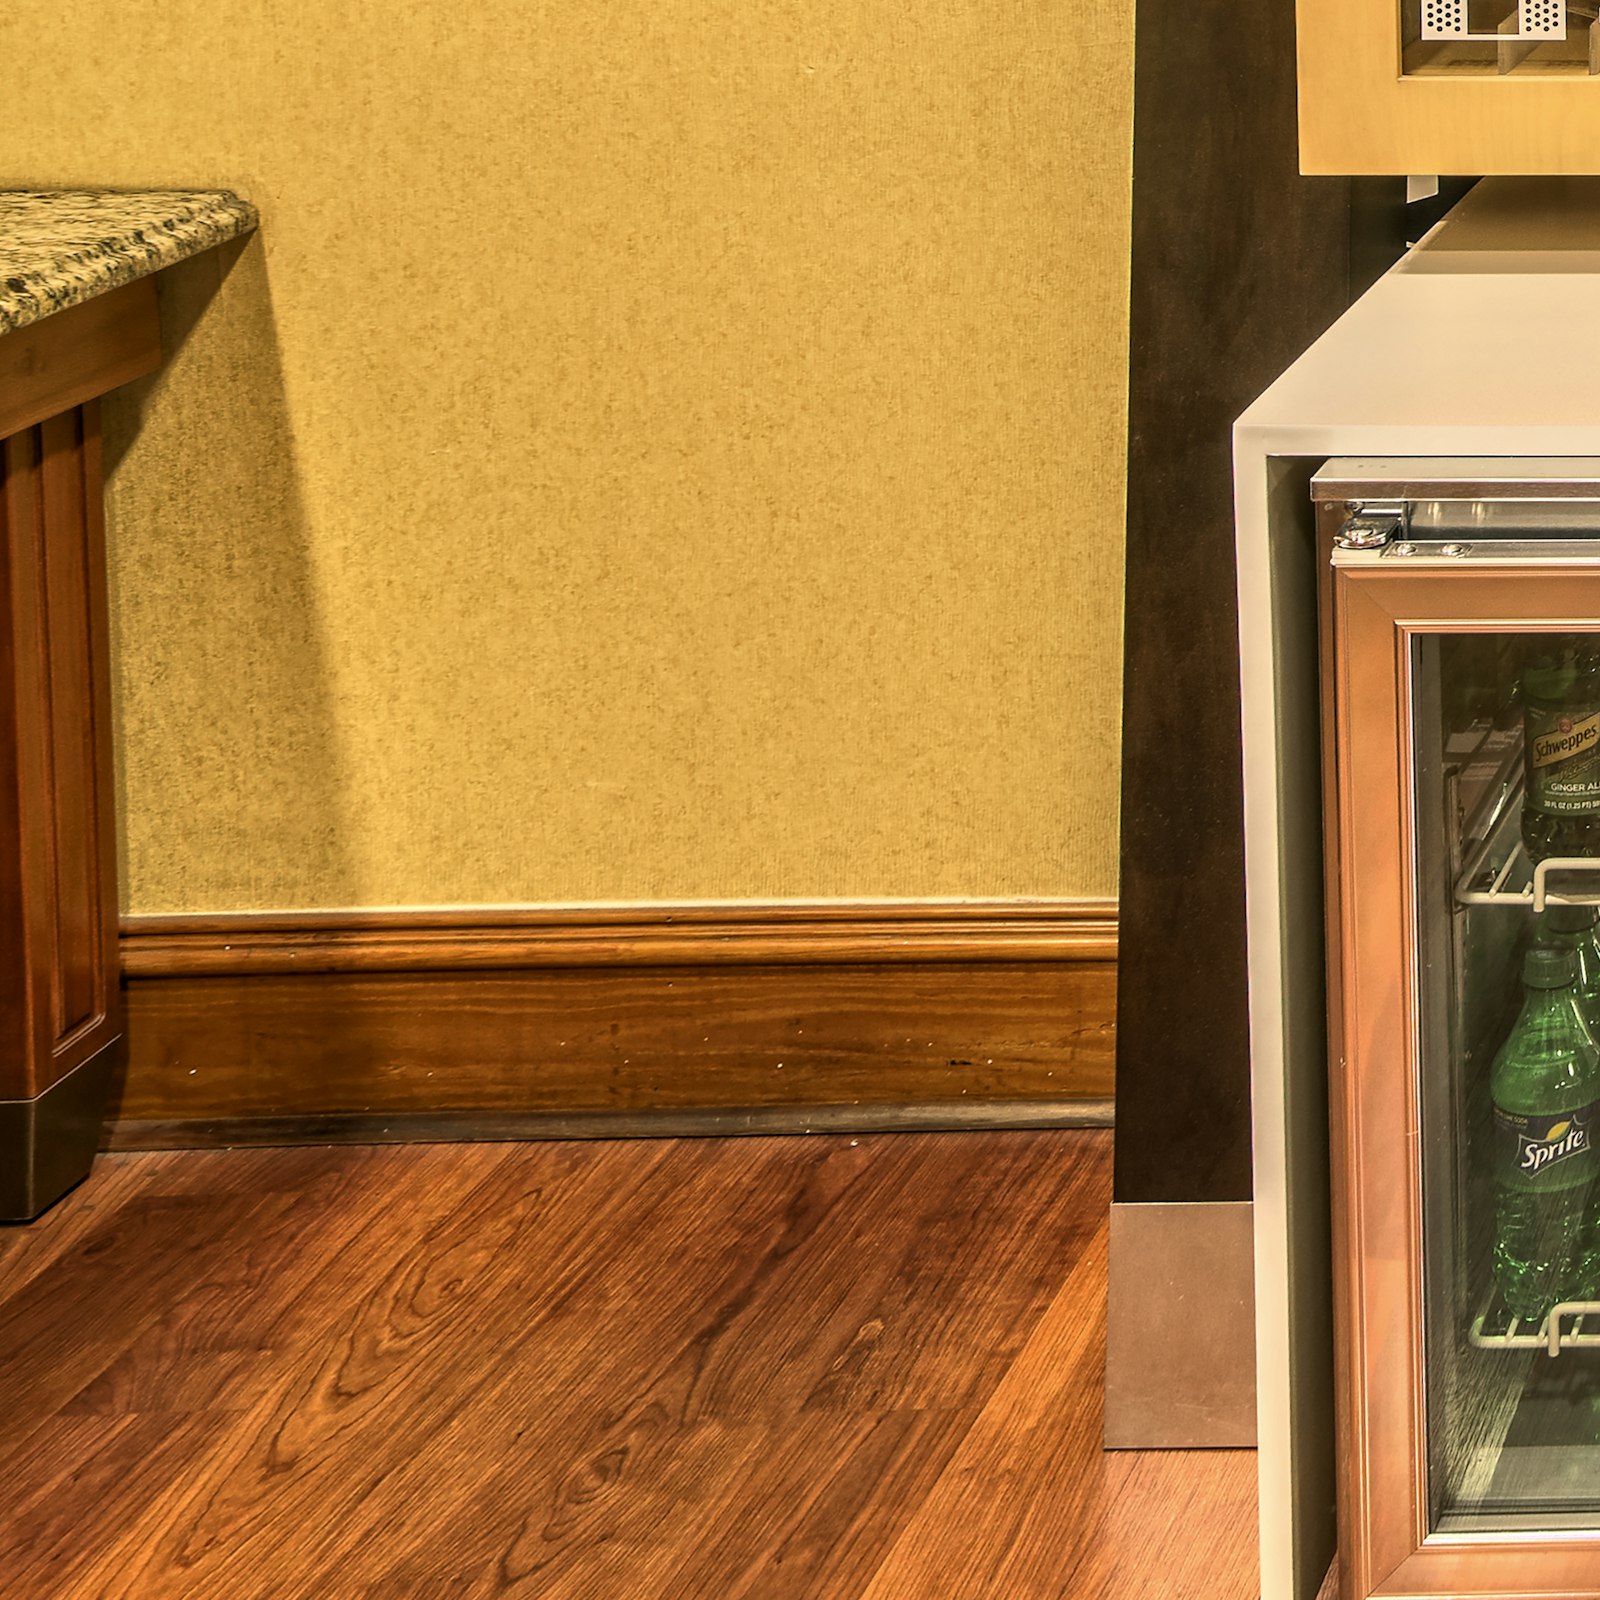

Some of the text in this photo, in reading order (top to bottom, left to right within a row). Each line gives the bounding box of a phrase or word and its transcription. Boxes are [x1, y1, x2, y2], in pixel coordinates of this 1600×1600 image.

[1534, 724, 1599, 762] Schweppes
[1550, 781, 1584, 792] GINGER
[1520, 1128, 1584, 1170] Sprite
